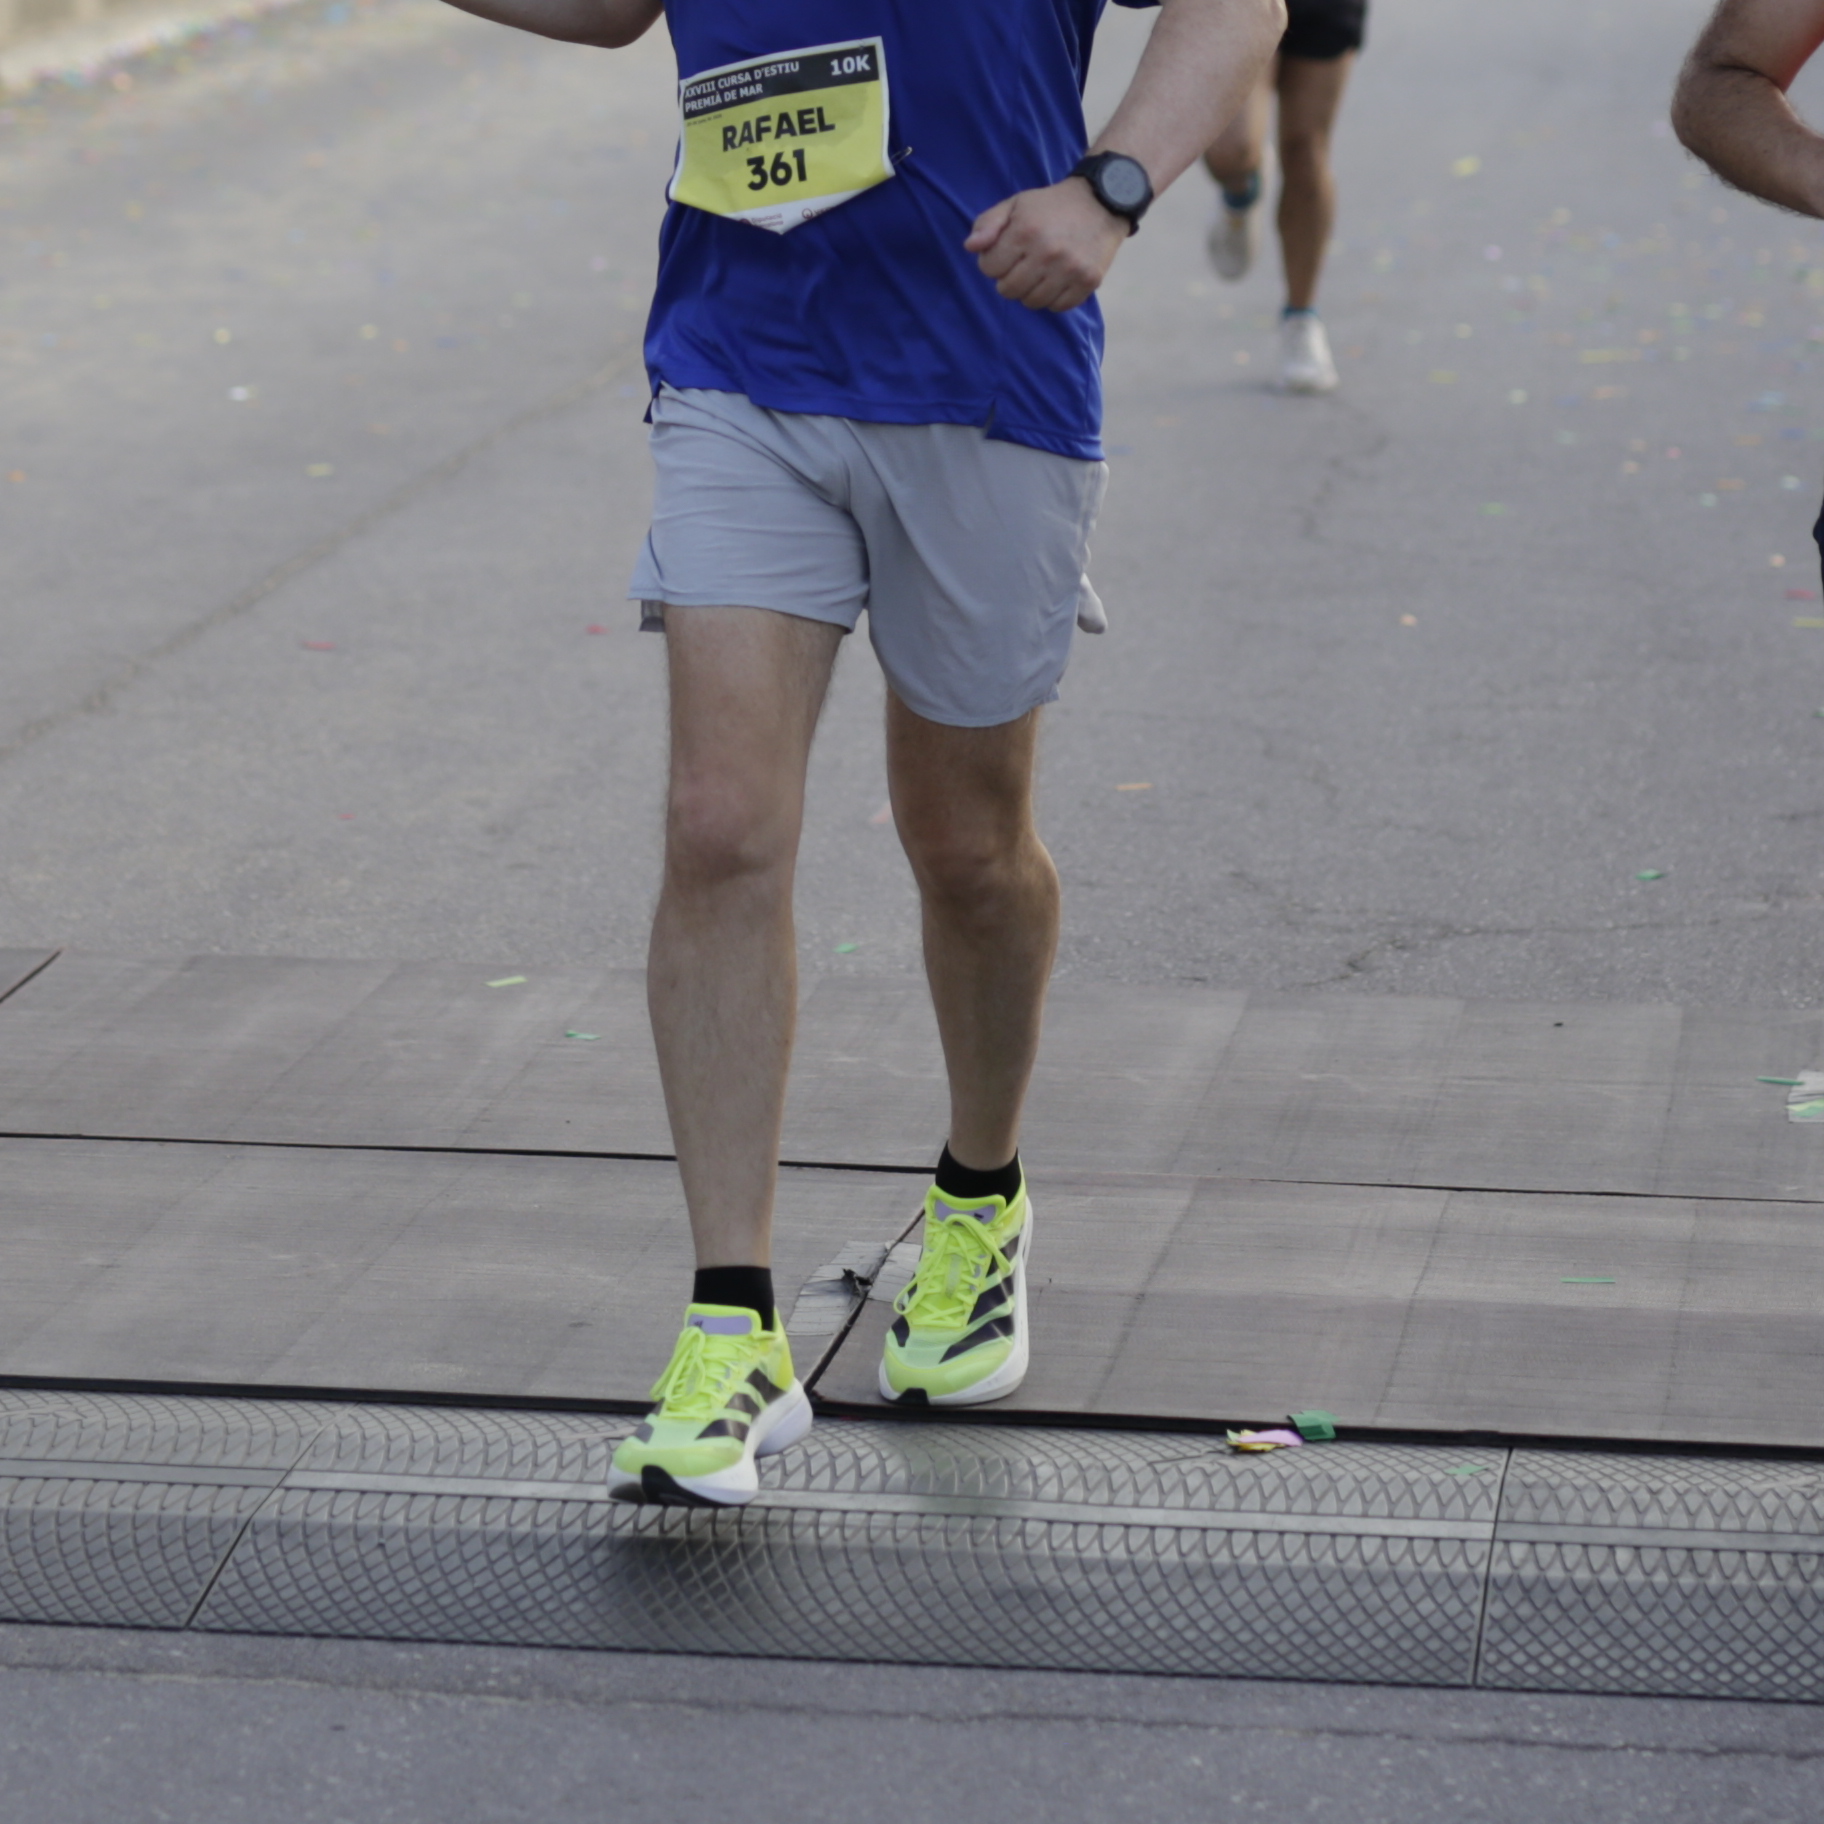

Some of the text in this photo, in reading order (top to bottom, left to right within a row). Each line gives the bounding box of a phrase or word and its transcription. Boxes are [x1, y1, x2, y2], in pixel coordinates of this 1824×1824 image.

[718, 71, 752, 89] CURSA
[754, 61, 800, 80] D'ESTIU
[830, 54, 871, 76] 10K
[685, 83, 764, 113] PREMIÀ DE MAR
[722, 106, 836, 152] RAFAEL
[746, 148, 807, 191] 361
